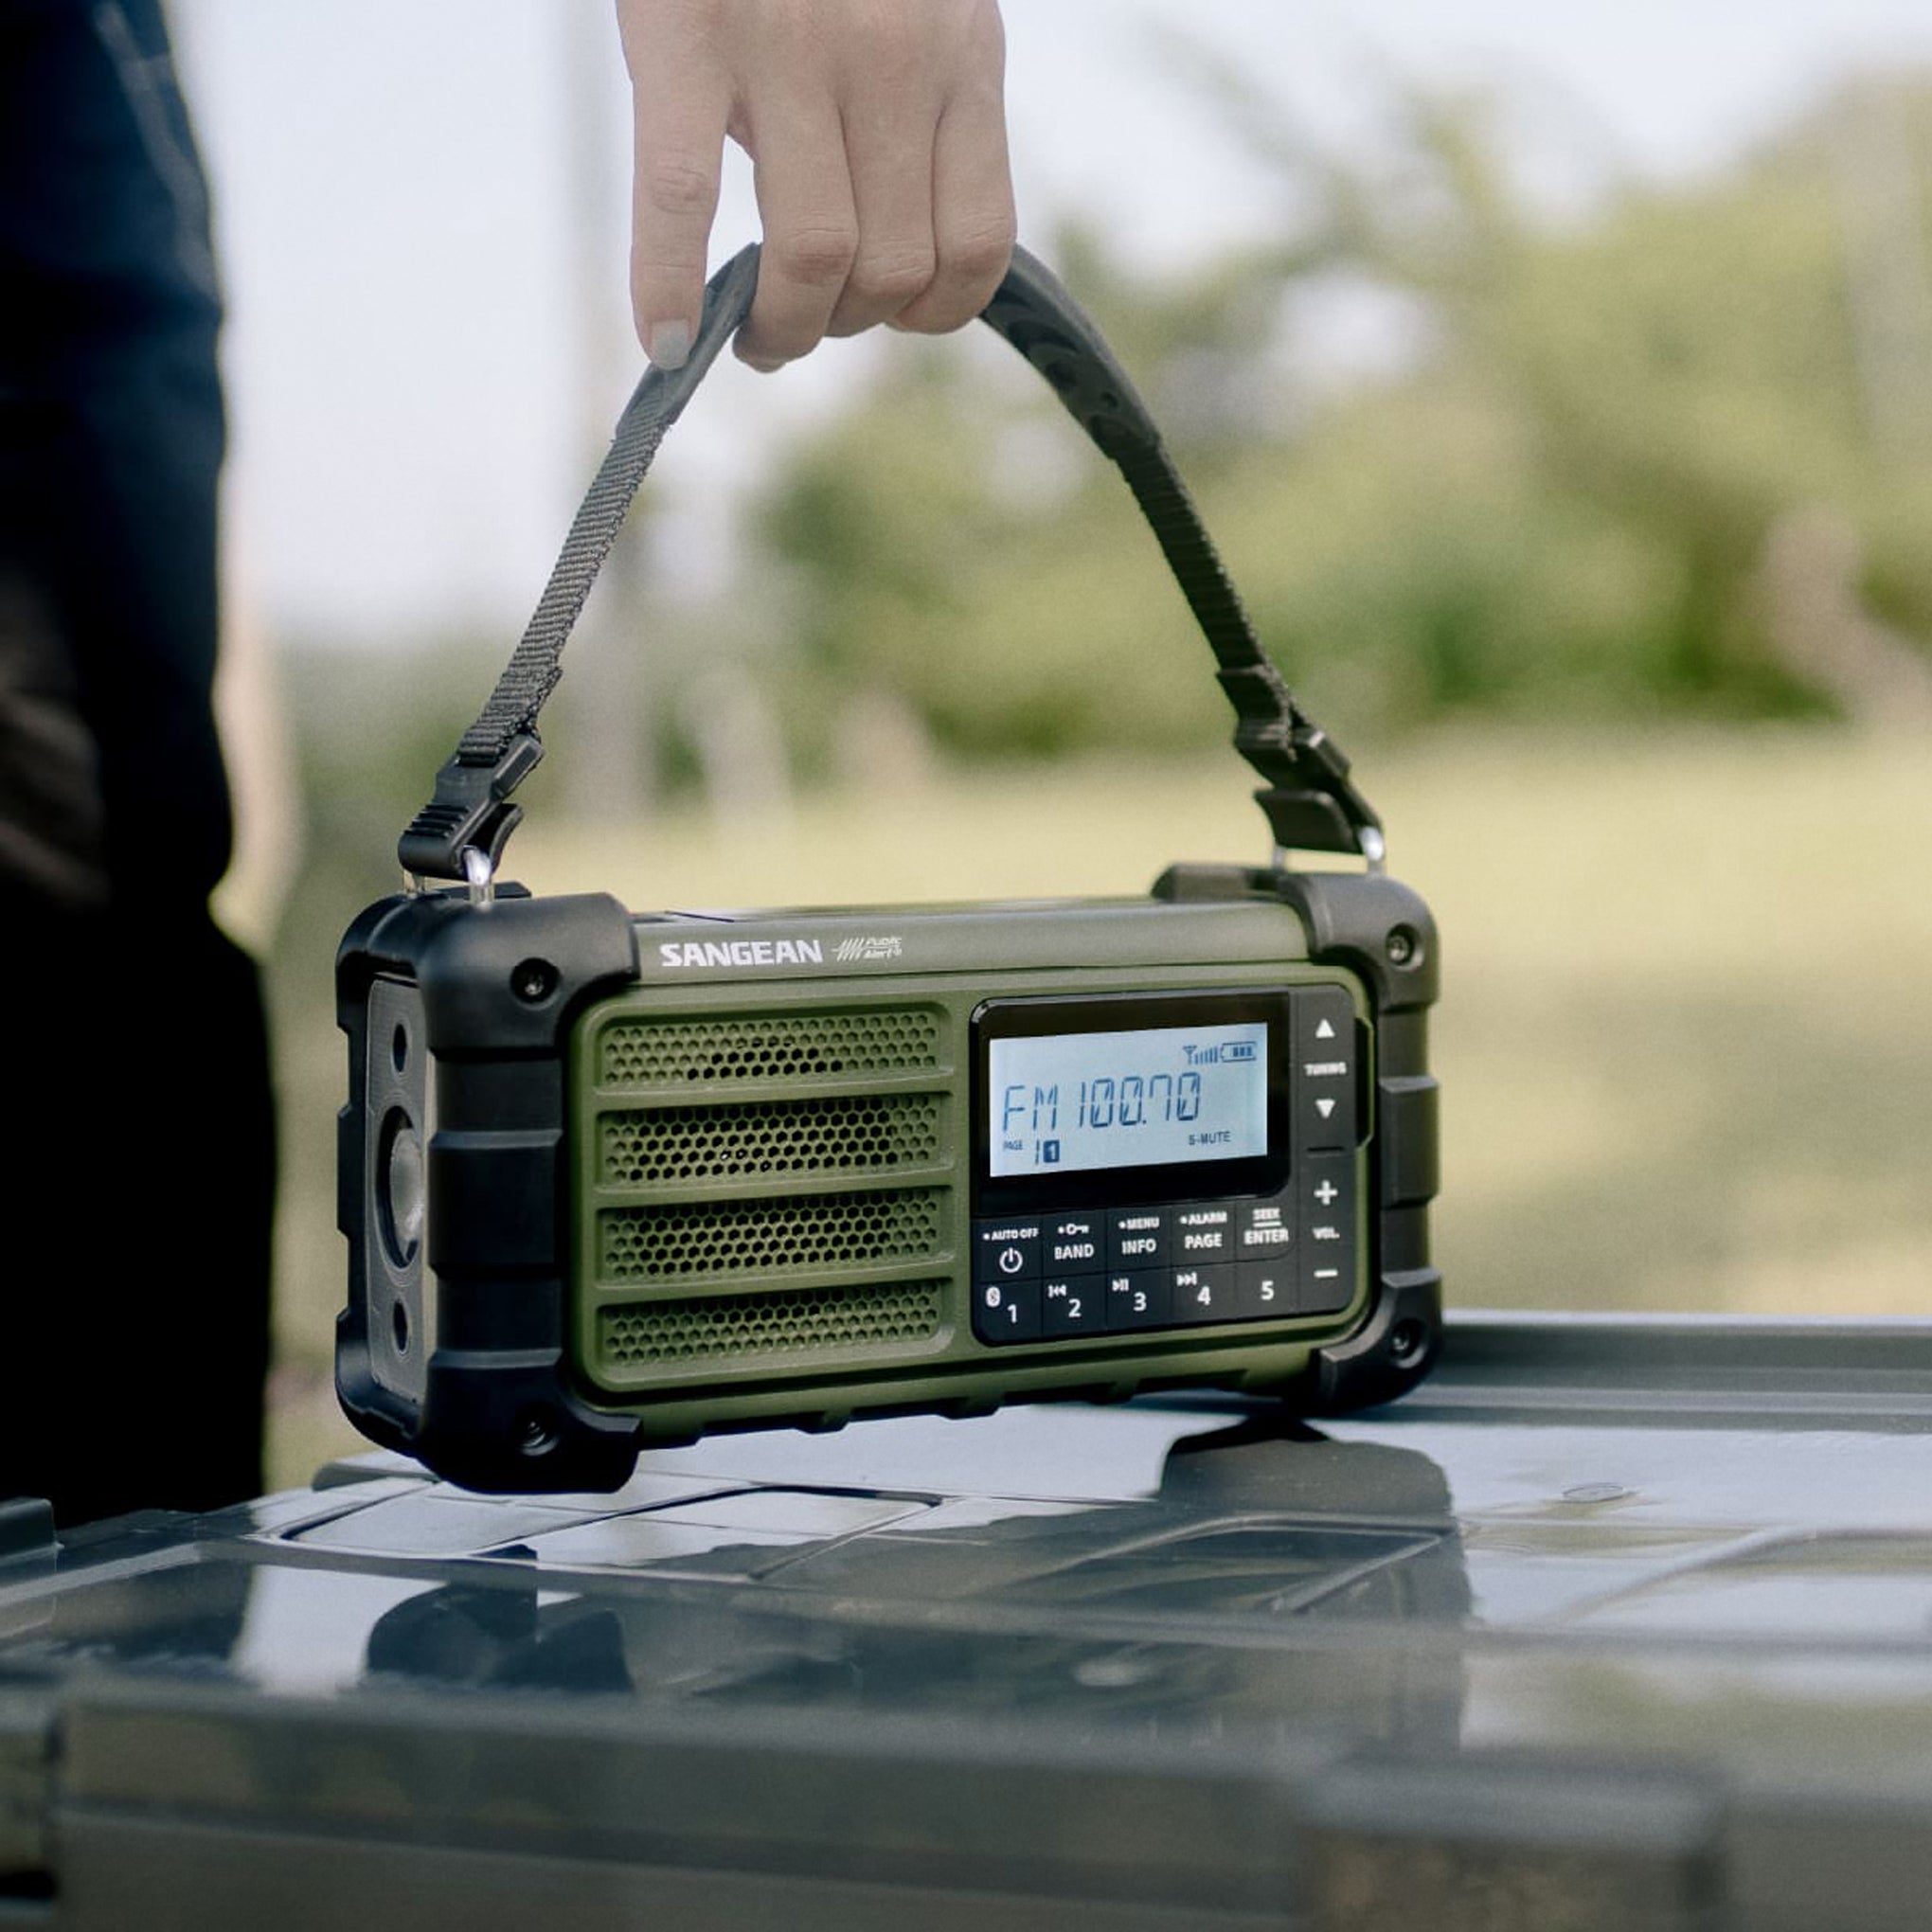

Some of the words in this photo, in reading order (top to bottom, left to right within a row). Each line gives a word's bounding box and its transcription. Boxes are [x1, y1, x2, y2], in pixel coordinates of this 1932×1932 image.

[659, 939, 824, 967] SANGEAN
[1002, 1083, 1059, 1132] FM
[1078, 1071, 1201, 1129] 100.70
[1189, 1131, 1231, 1146] S-MUTE
[1126, 1217, 1160, 1230] MENU
[1188, 1211, 1228, 1225] ALARM
[1252, 1208, 1281, 1221] SEEK
[992, 1229, 1019, 1242] AUTO
[1020, 1227, 1039, 1239] OFF
[1185, 1233, 1223, 1249] PAGE
[1243, 1227, 1289, 1245] ENTER
[1054, 1243, 1095, 1261] BAND
[1121, 1239, 1157, 1255] INFO
[1197, 1286, 1211, 1306] 4
[1261, 1280, 1275, 1301] 5
[1068, 1298, 1082, 1317] 2
[1134, 1292, 1147, 1312] 3
[1007, 1304, 1018, 1324] 1
